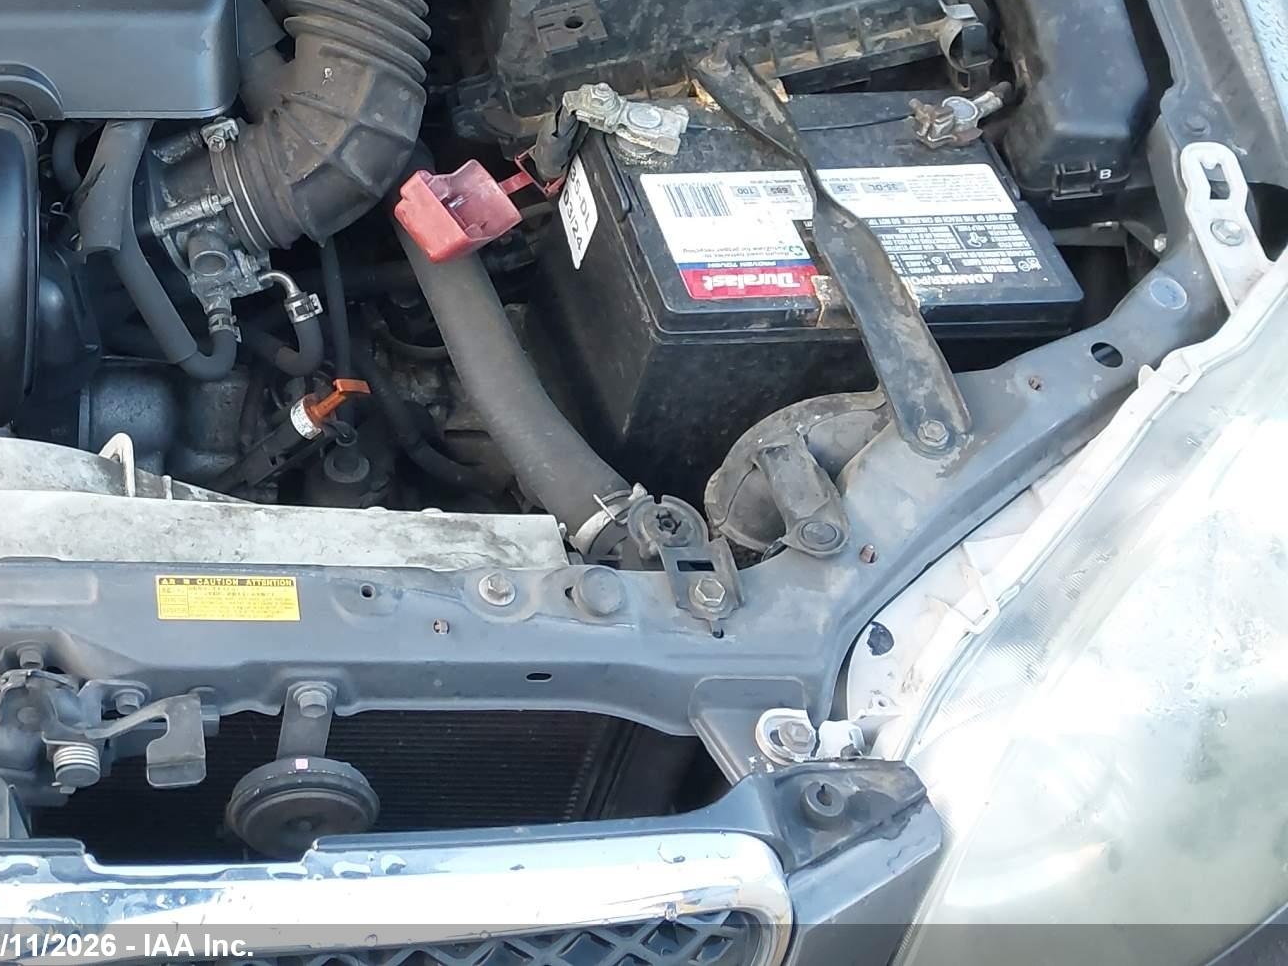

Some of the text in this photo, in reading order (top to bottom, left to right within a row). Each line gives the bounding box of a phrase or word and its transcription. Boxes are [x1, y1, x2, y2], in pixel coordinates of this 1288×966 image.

[1099, 168, 1112, 180] B
[569, 164, 591, 232] 35-DL
[563, 188, 583, 252] 03/24
[702, 272, 801, 291] Duralast
[197, 578, 239, 586] CAUTION
[246, 578, 292, 586] ATTENTION
